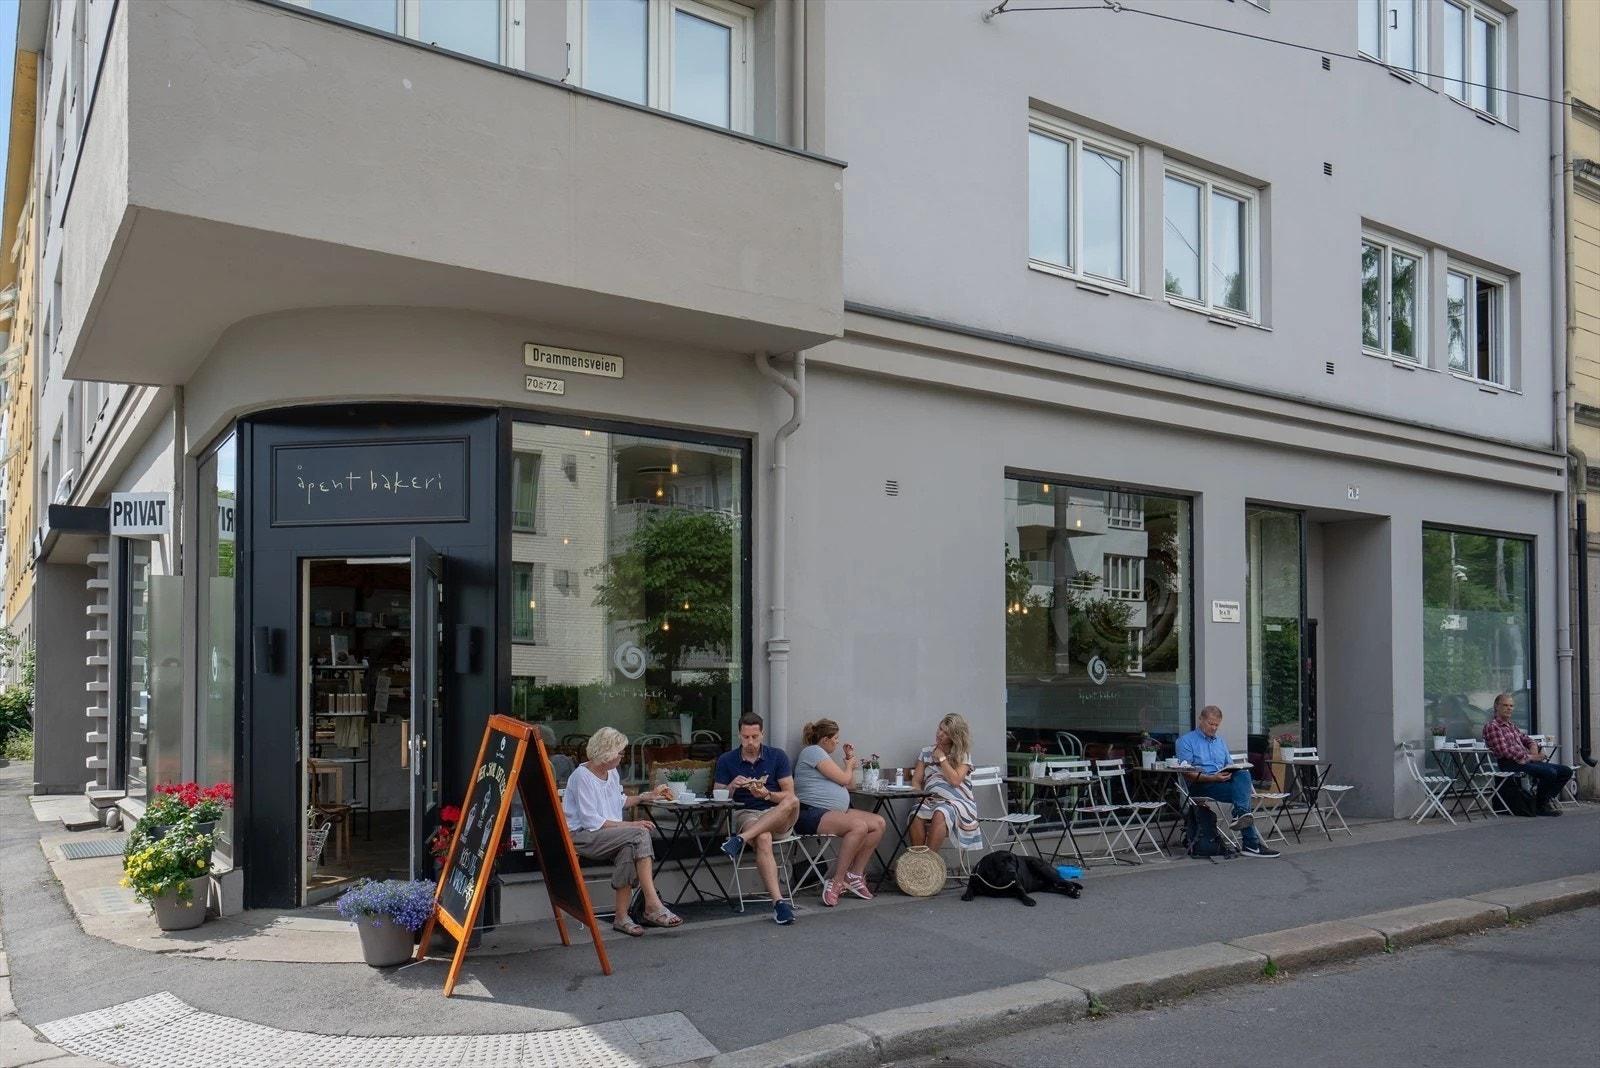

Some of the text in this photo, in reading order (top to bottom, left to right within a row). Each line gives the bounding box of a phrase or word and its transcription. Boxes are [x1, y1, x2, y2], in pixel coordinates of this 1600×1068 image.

[533, 348, 616, 372] Drammensveien
[297, 465, 442, 504] åpent bakeri
[113, 500, 166, 526] PRIVAT
